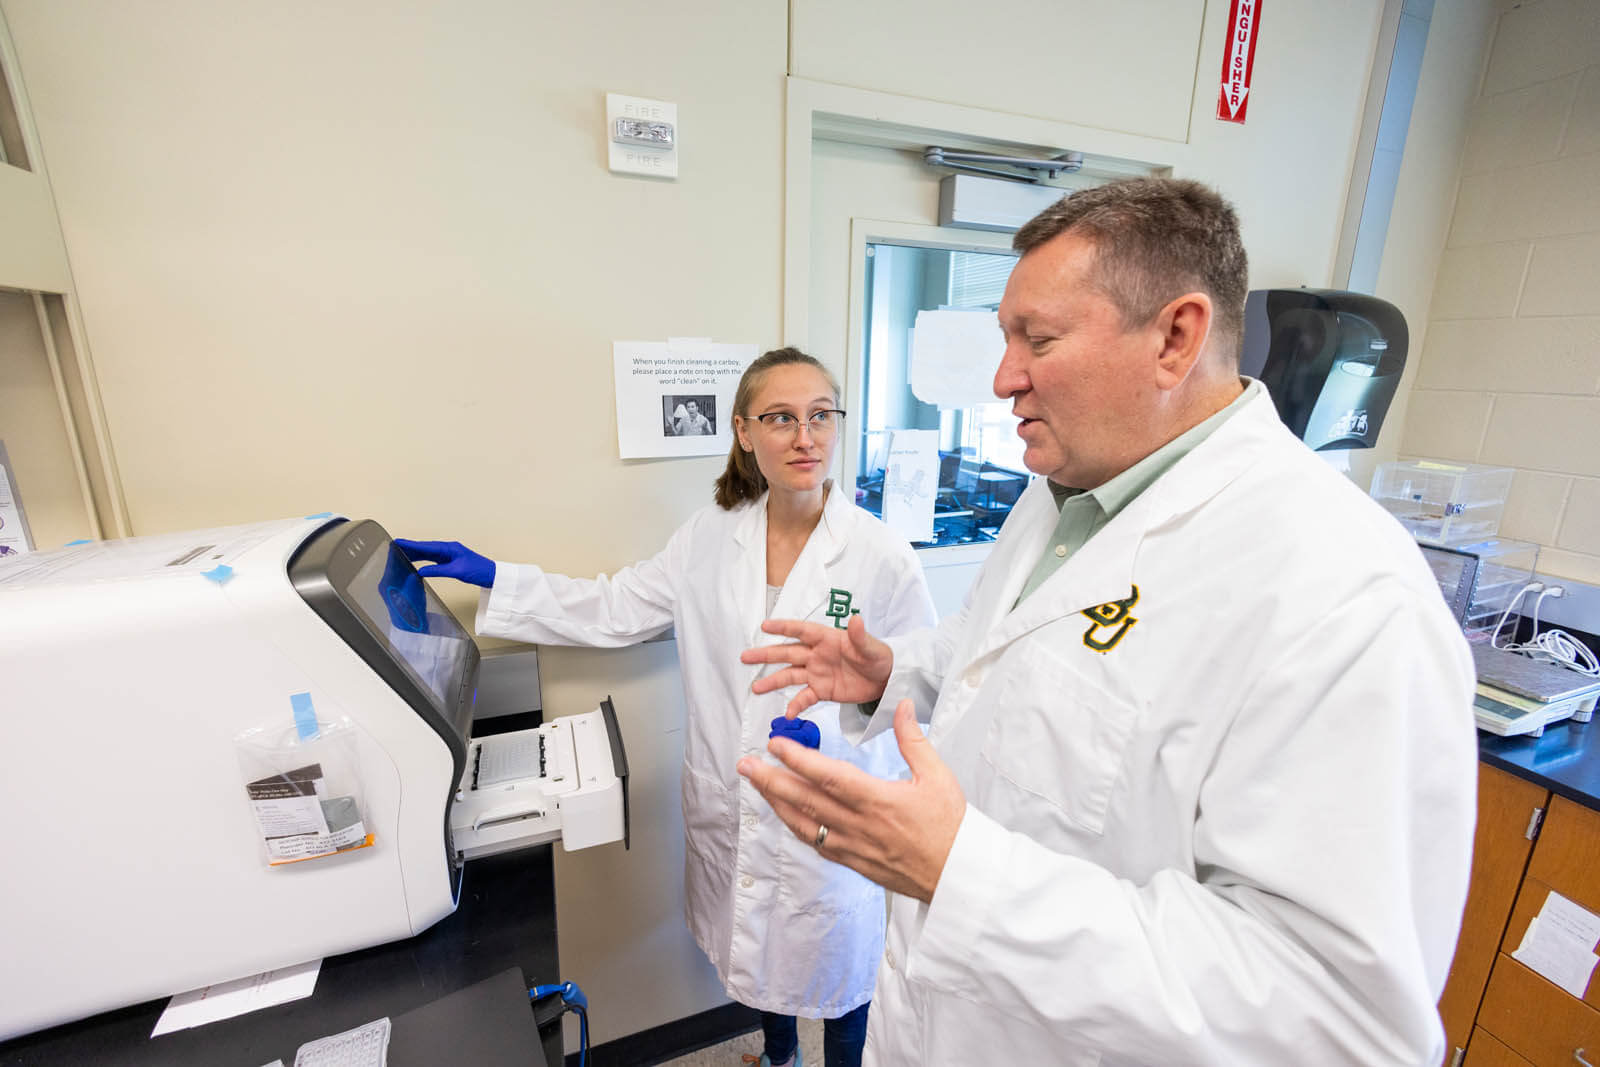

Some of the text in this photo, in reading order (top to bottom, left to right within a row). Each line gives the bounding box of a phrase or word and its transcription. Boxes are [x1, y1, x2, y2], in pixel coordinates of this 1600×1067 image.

[1230, 0, 1251, 106] NGUISHER
[624, 103, 662, 119] FIRE
[626, 151, 664, 168] FIRE
[632, 358, 653, 366] When
[654, 359, 667, 367] you
[667, 358, 685, 366] finish
[686, 358, 712, 367] cleaning
[718, 358, 741, 367] carboy,
[632, 368, 654, 376] please
[654, 368, 672, 376] place
[704, 368, 716, 376] top
